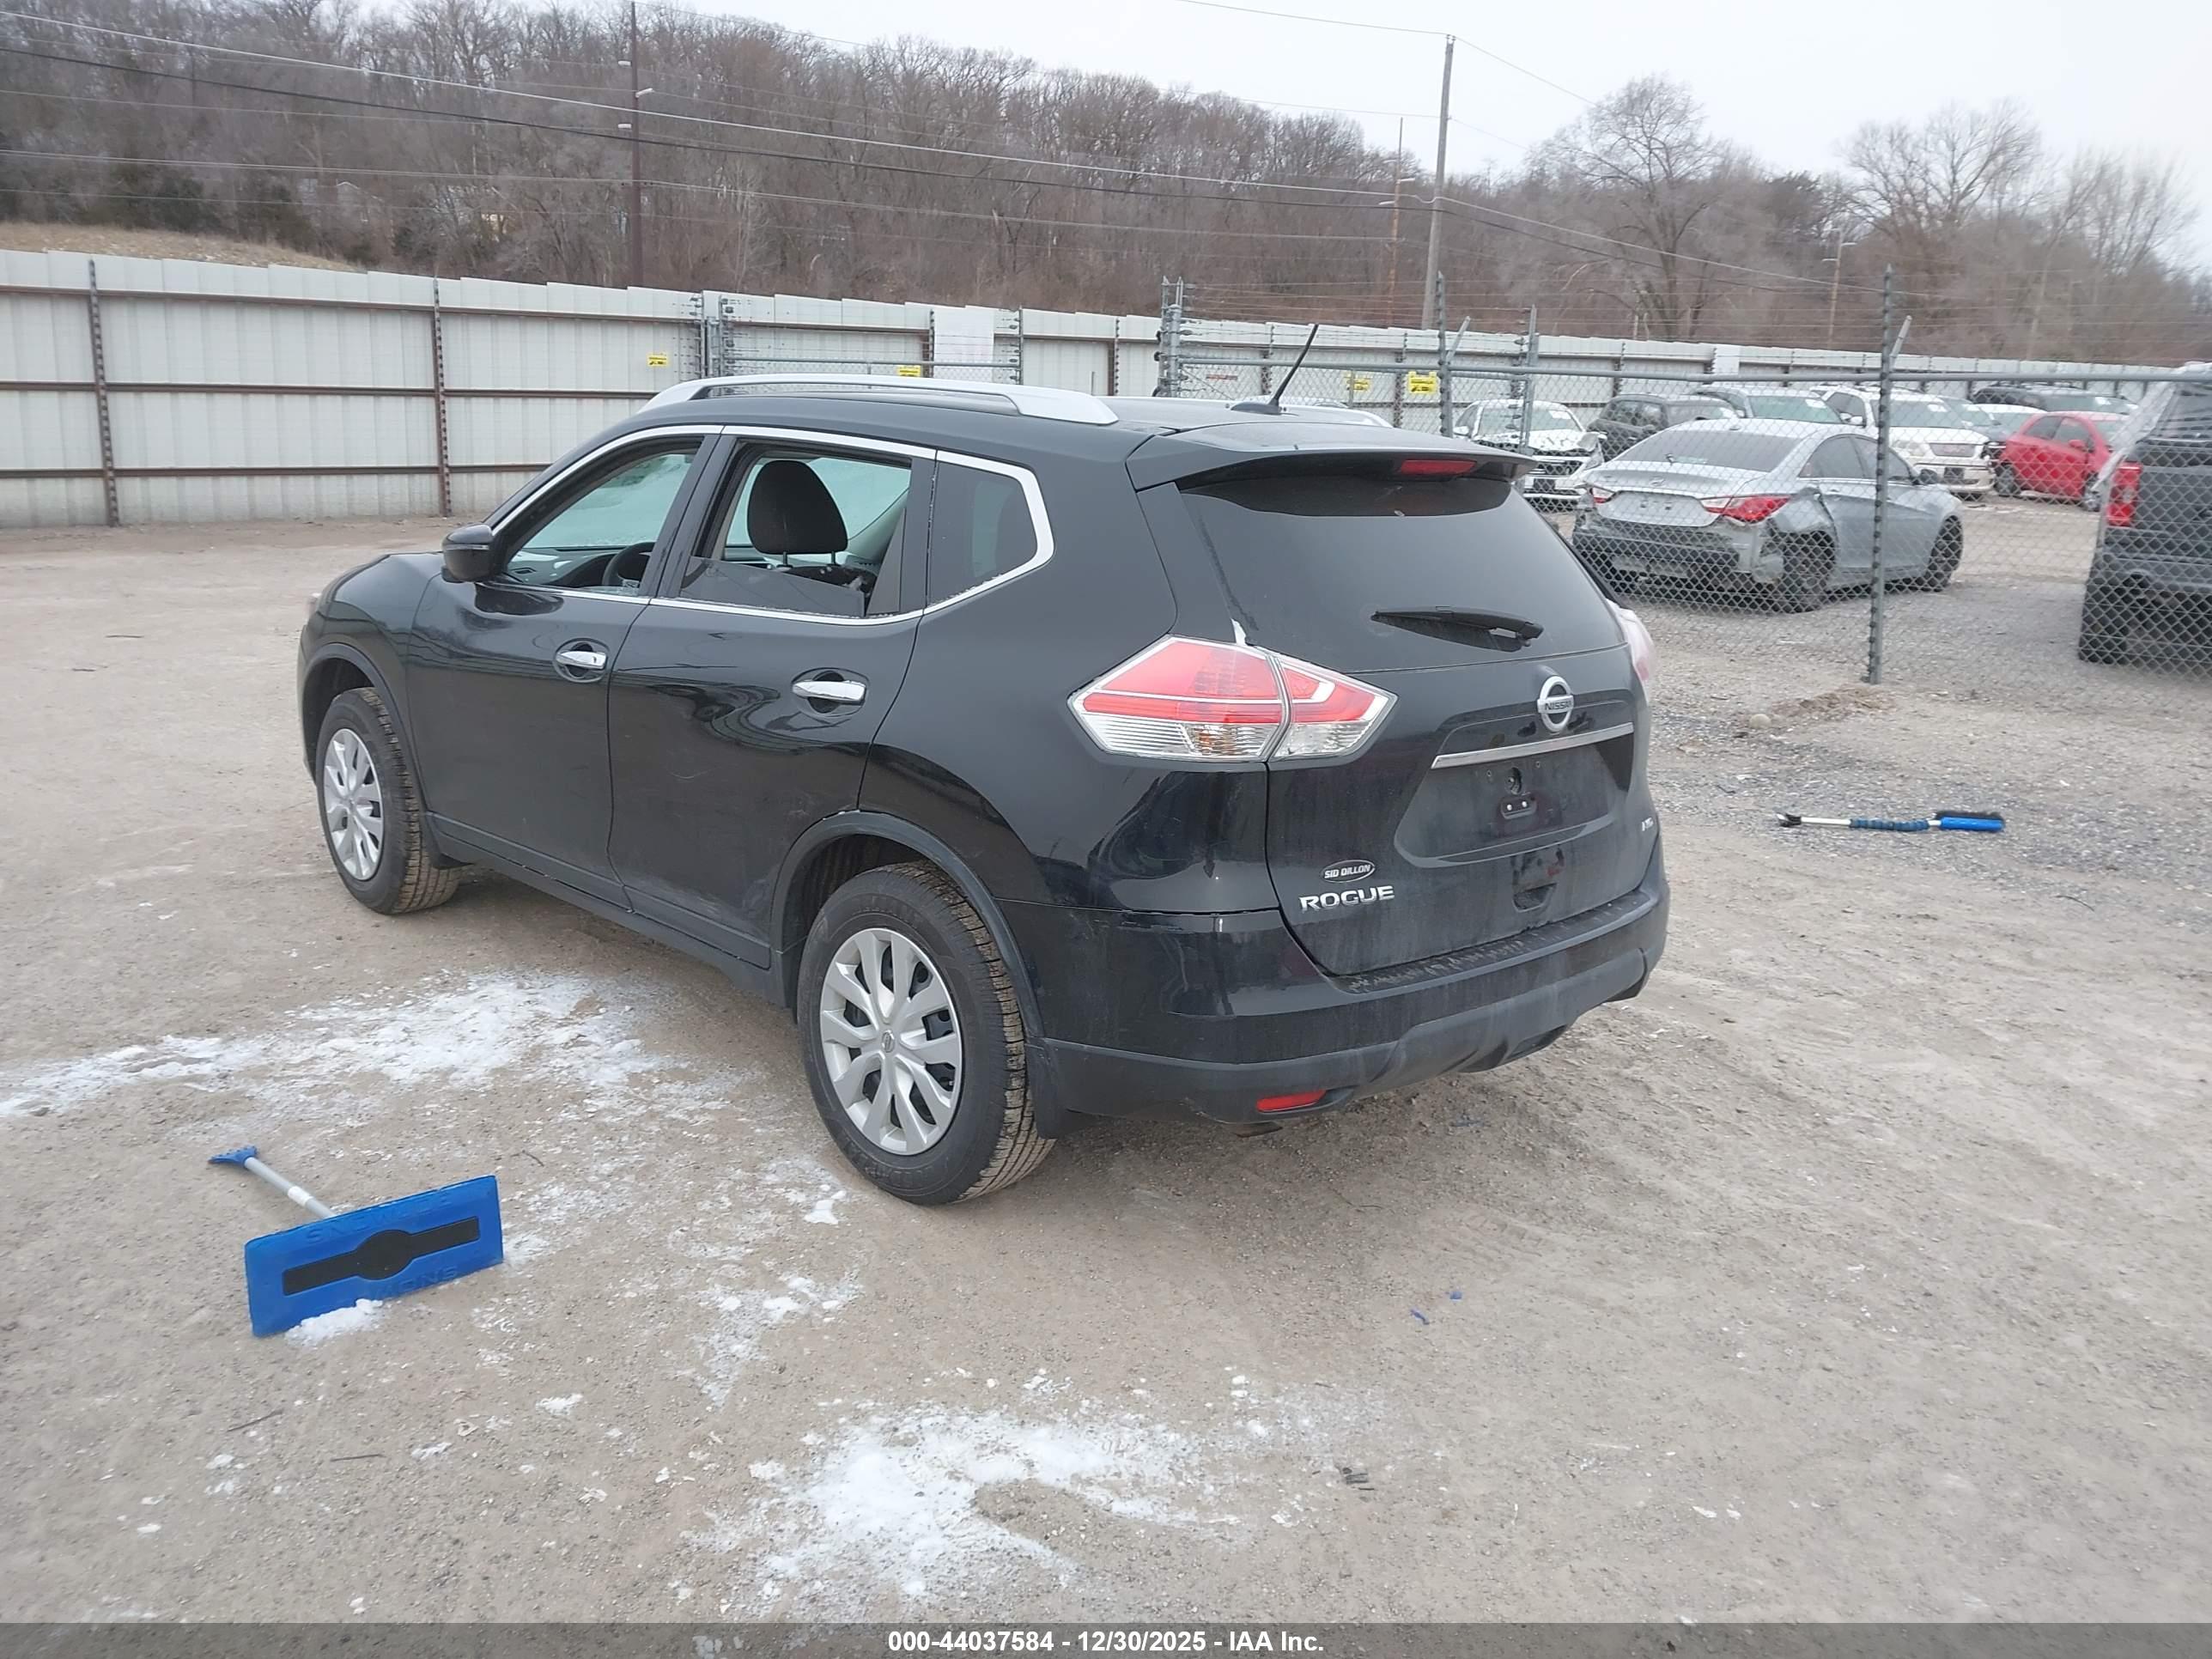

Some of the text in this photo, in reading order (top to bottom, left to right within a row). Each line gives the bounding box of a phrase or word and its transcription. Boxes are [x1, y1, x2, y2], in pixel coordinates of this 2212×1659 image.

[1324, 864, 1371, 878] SID DILLON
[1298, 885, 1395, 912] ROGUE
